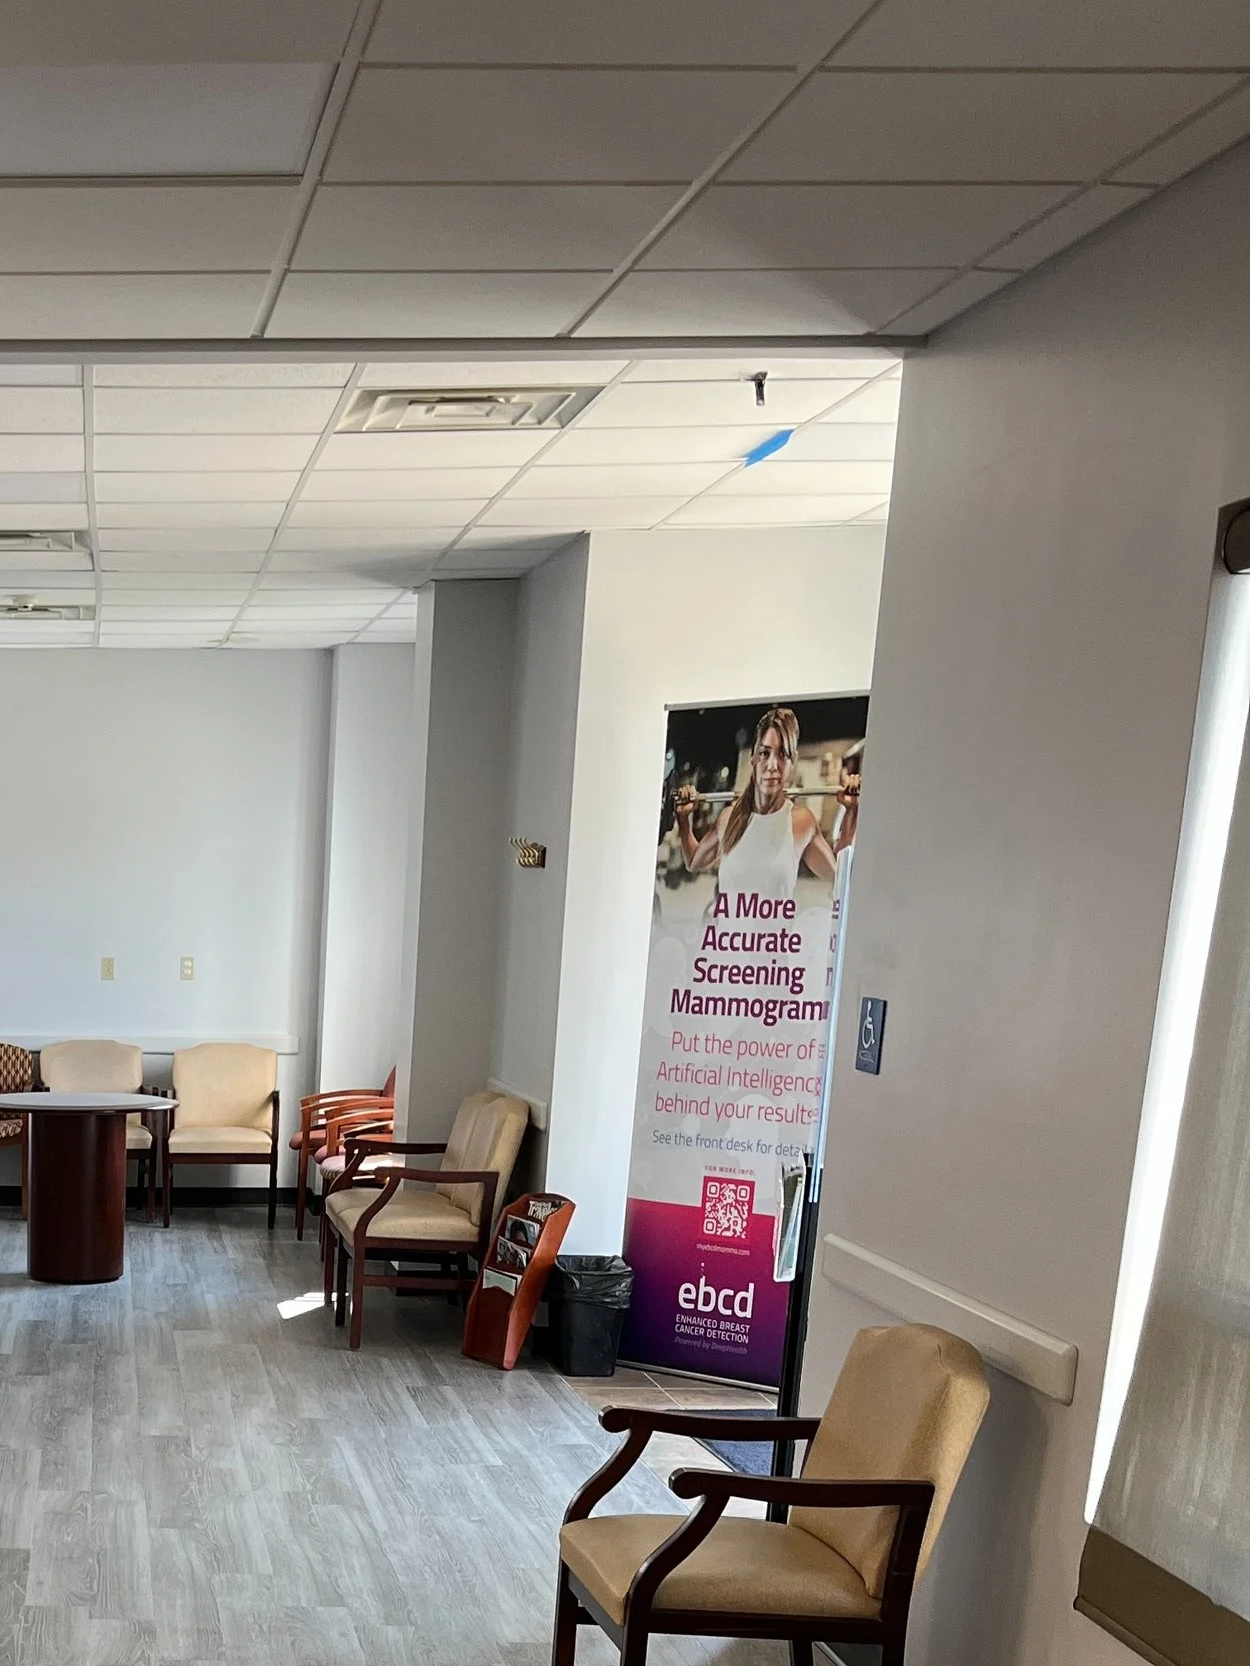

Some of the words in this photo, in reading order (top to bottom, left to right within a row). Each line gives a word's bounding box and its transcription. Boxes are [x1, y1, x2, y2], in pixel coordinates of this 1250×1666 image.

[713, 893, 730, 919] A
[735, 892, 796, 920] More
[701, 925, 802, 954] Accurate
[693, 957, 806, 995] Screening
[670, 989, 823, 1027] Mammogram
[671, 1031, 700, 1053] Put
[704, 1033, 733, 1055] the
[736, 1039, 793, 1061] power
[796, 1038, 817, 1060] of
[656, 1061, 721, 1086] Artificial
[655, 1091, 710, 1116] behind
[714, 1102, 754, 1123] your
[652, 1130, 672, 1145] See
[674, 1132, 693, 1147] the
[695, 1135, 724, 1151] front
[726, 1137, 753, 1152] desk
[756, 1140, 772, 1154] for
[704, 1164, 717, 1172] FOR
[678, 1275, 755, 1319] ebcd
[674, 1324, 705, 1336] CANCER
[706, 1328, 749, 1344] DETECTION
[675, 1314, 718, 1329] ENHANCED
[719, 1320, 751, 1334] BREAST
[674, 1336, 701, 1348] Powered
[702, 1340, 710, 1351] by
